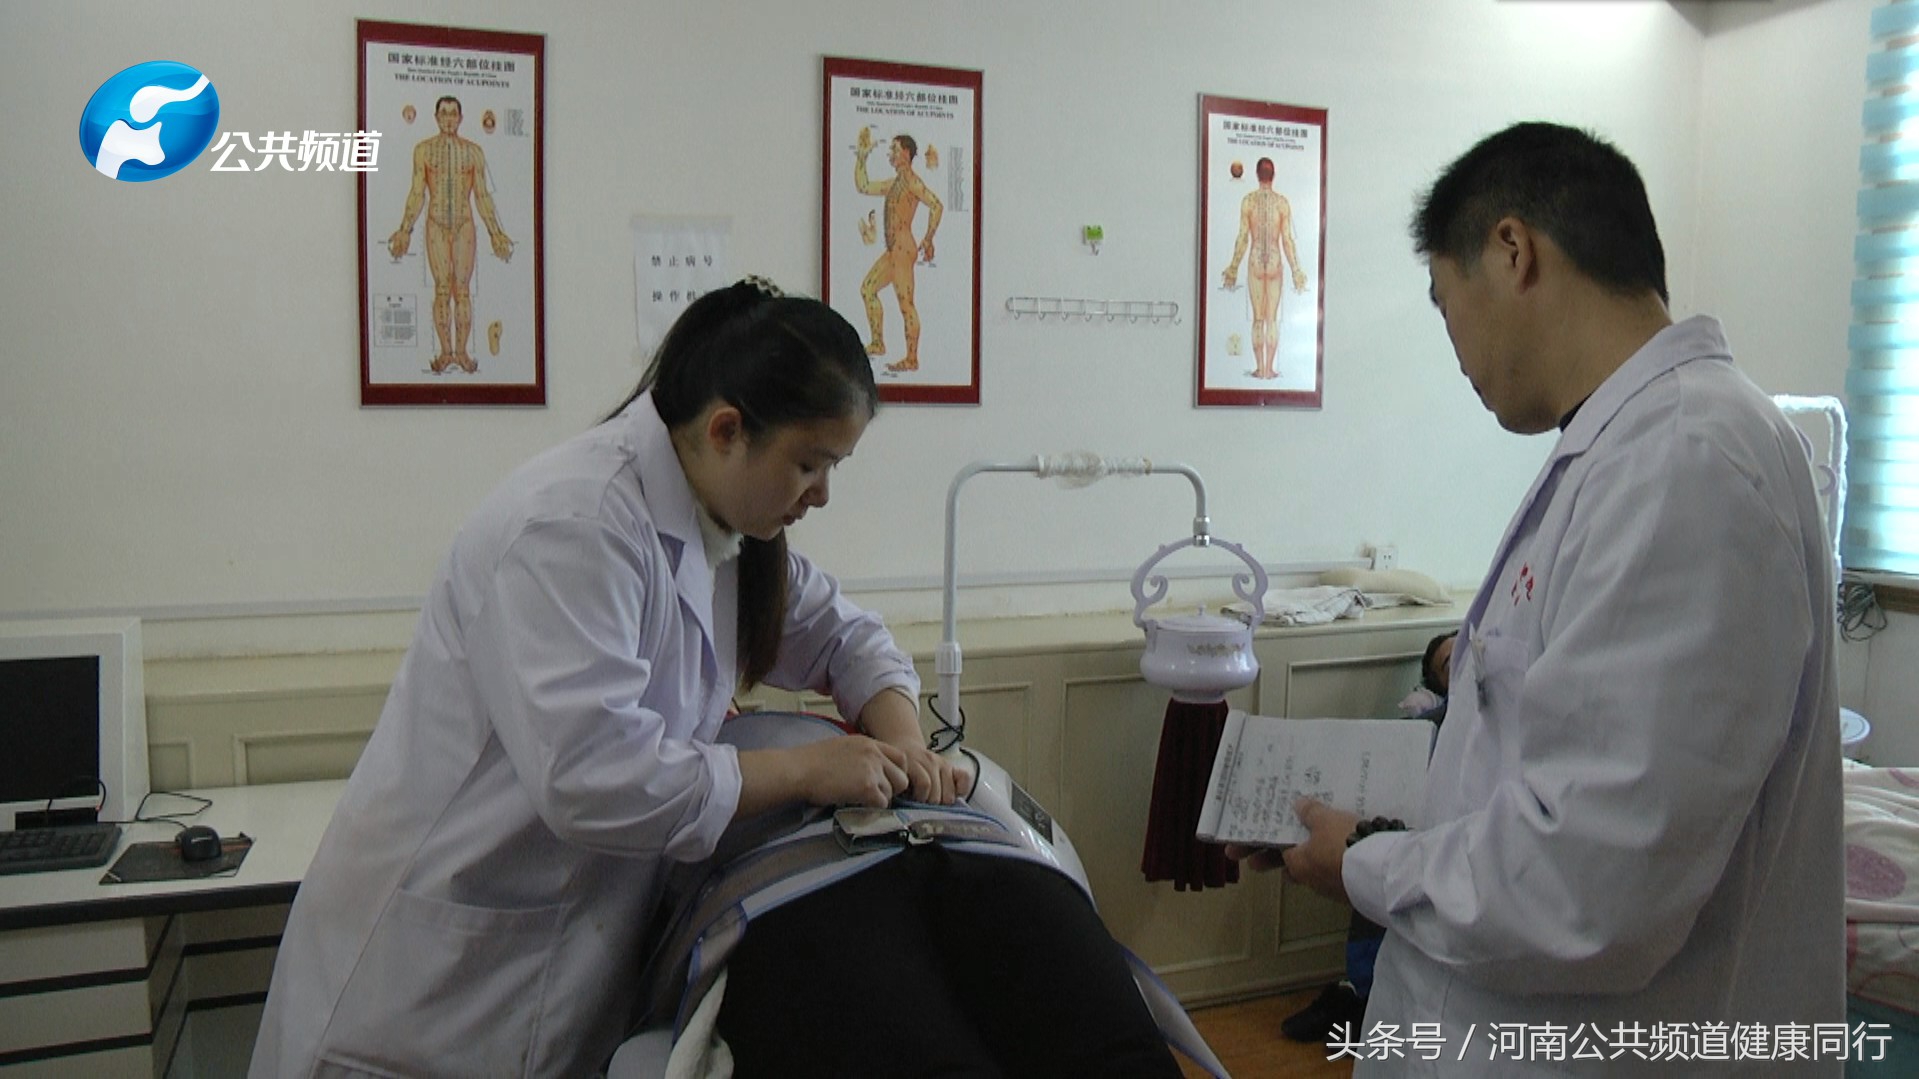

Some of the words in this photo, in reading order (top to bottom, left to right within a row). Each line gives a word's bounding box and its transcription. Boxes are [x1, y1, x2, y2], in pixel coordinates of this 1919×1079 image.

[388, 52, 516, 72] 国家标准经穴部位挂图
[394, 73, 409, 81] THE
[412, 74, 453, 84] LOCATION
[454, 77, 464, 85] OF
